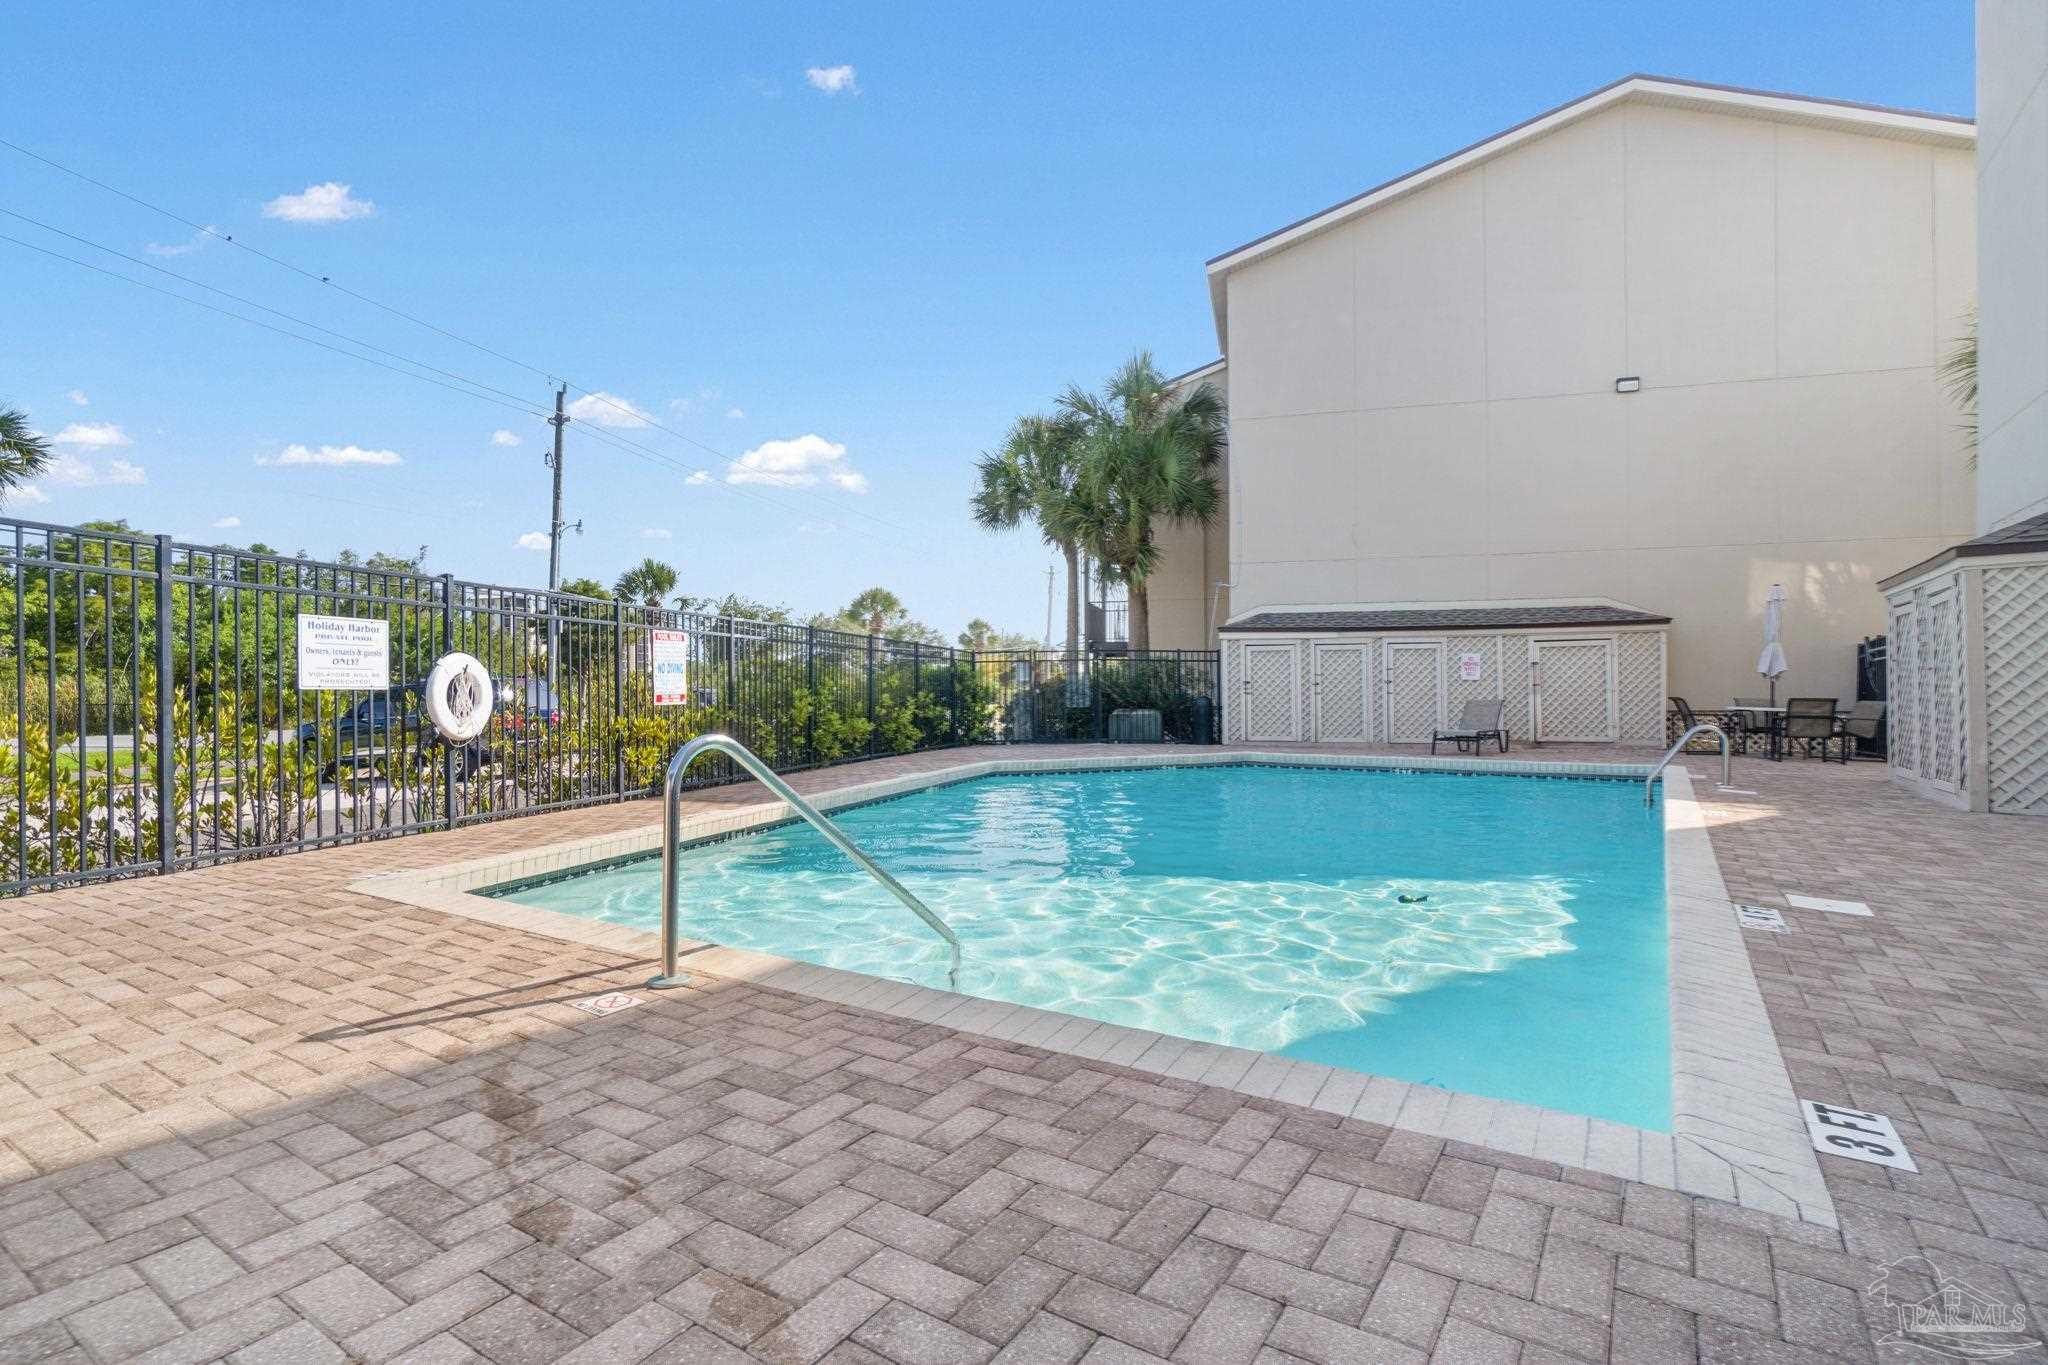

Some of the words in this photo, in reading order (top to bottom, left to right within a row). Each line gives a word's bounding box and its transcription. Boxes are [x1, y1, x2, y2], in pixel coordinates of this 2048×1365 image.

[307, 621, 344, 632] Holiday
[348, 623, 379, 633] Harbor
[305, 646, 330, 655] Owners,
[333, 648, 355, 656] tenants
[657, 663, 666, 673] NO
[667, 663, 684, 674] DIVING
